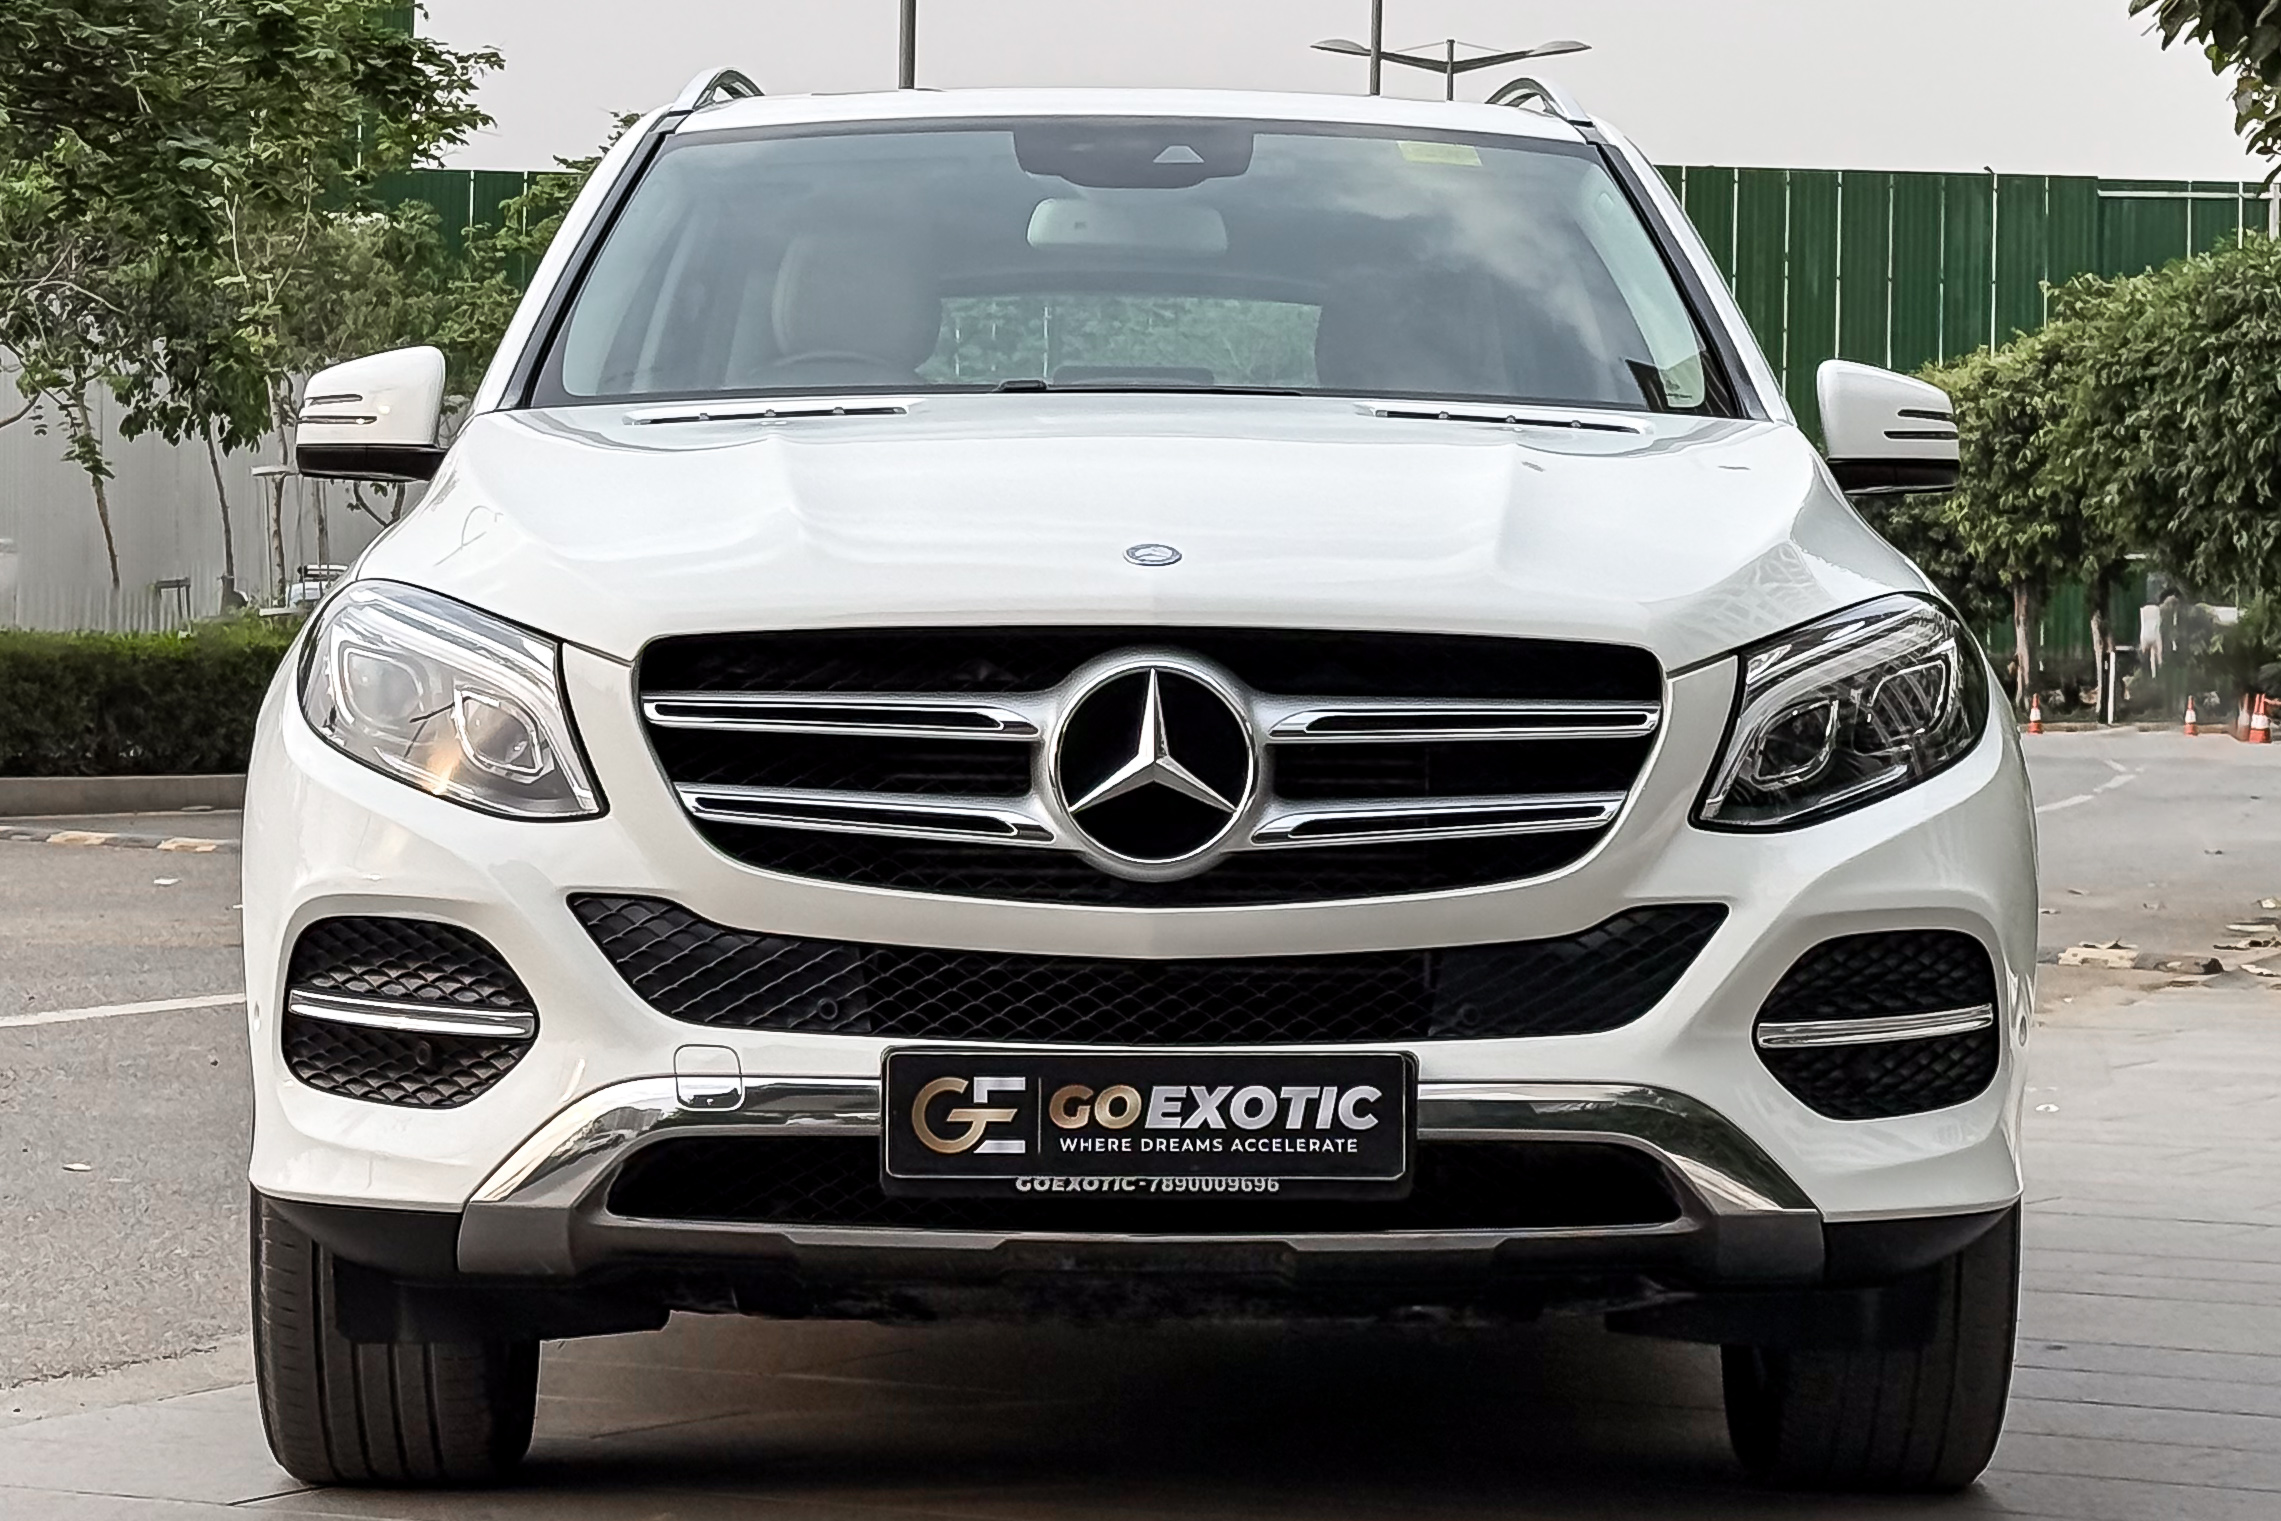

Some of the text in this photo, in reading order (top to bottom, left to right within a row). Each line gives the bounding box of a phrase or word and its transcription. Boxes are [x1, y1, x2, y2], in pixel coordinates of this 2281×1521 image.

[1049, 1084, 1381, 1130] GOEXOTIC
[1059, 1138, 1358, 1153] WHERE DREAMS ACCELERATE
